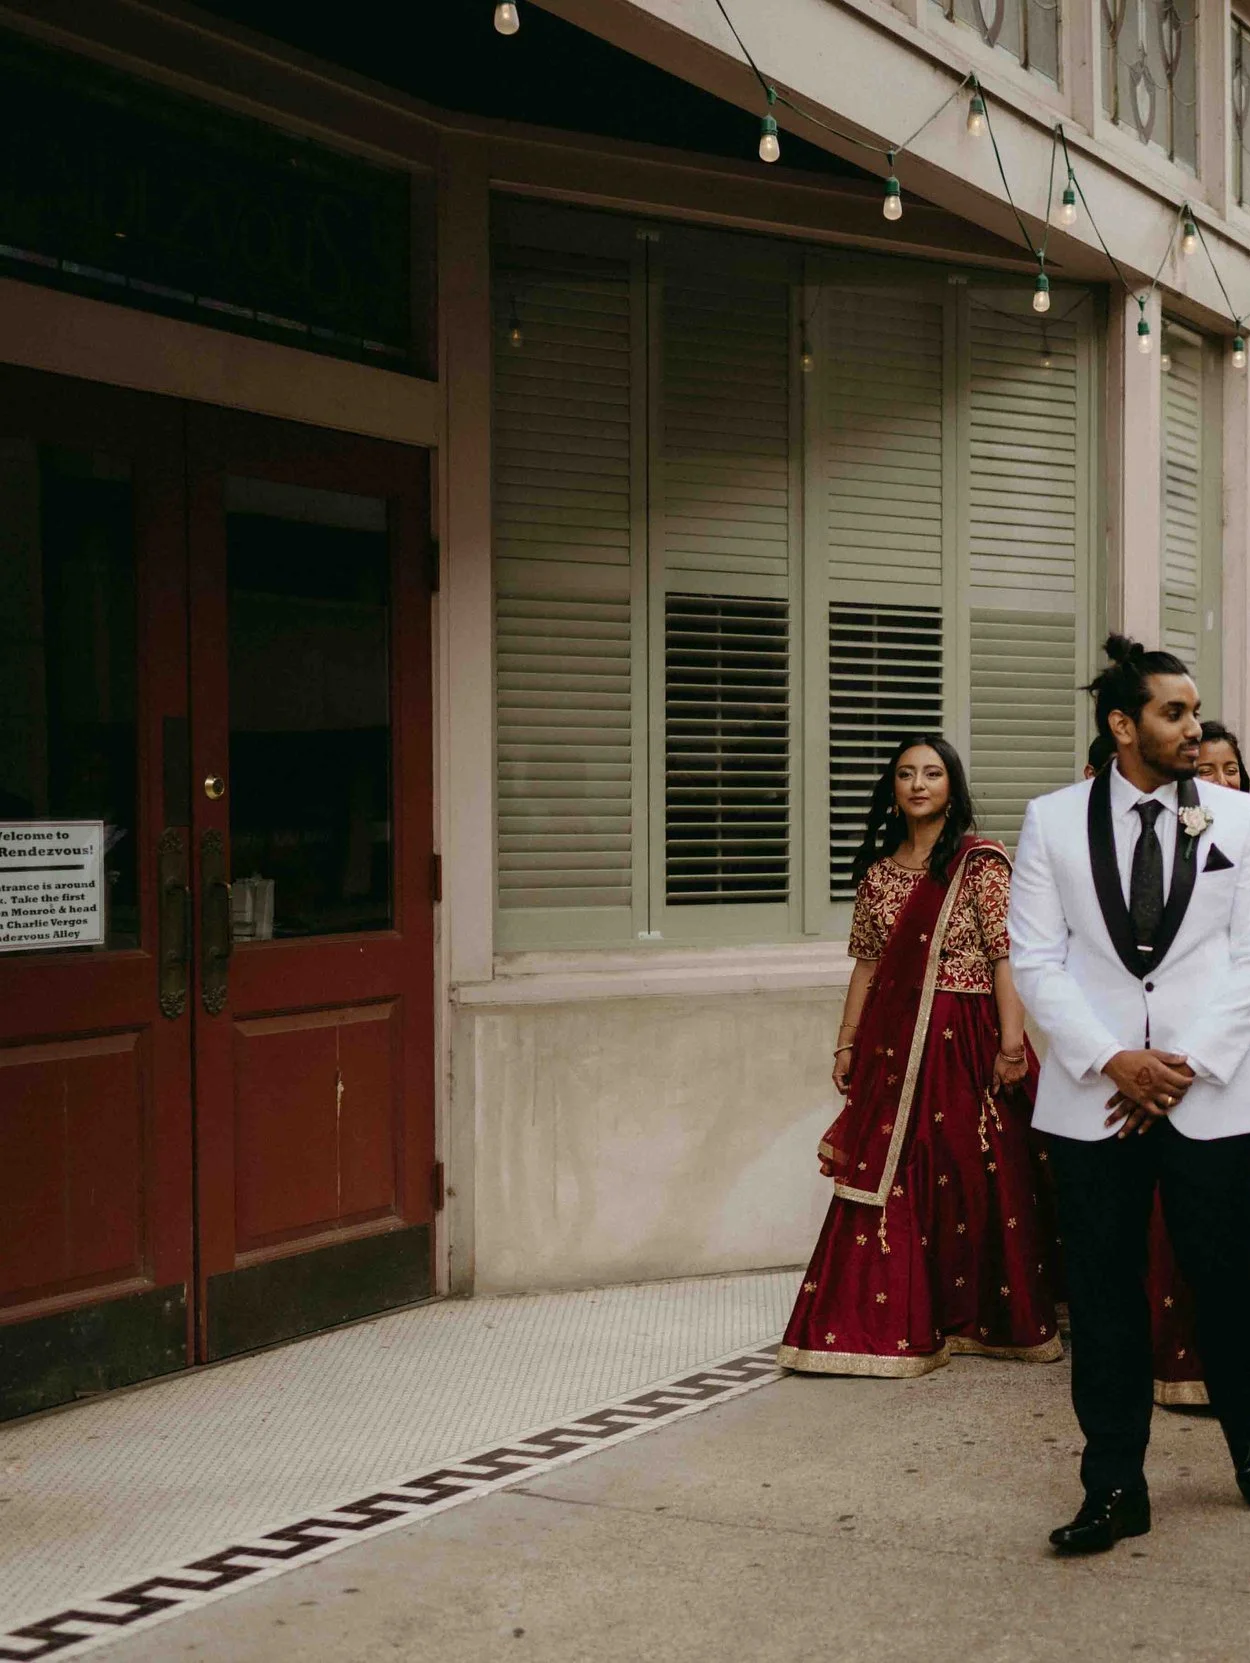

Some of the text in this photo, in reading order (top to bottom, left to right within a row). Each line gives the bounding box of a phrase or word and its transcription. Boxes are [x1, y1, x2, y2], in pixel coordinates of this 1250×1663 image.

[0, 831, 70, 841] elcome to
[0, 845, 94, 858] Rendezvous!
[0, 880, 96, 892] trance is around
[10, 895, 39, 904] Take
[41, 893, 60, 903] the
[62, 892, 86, 902] first
[11, 907, 56, 917] Monroe
[58, 906, 67, 914] &
[69, 904, 97, 914] head
[6, 919, 49, 929] Charlie
[51, 918, 89, 928] Vergos
[0, 930, 81, 942] dezvous Alley
